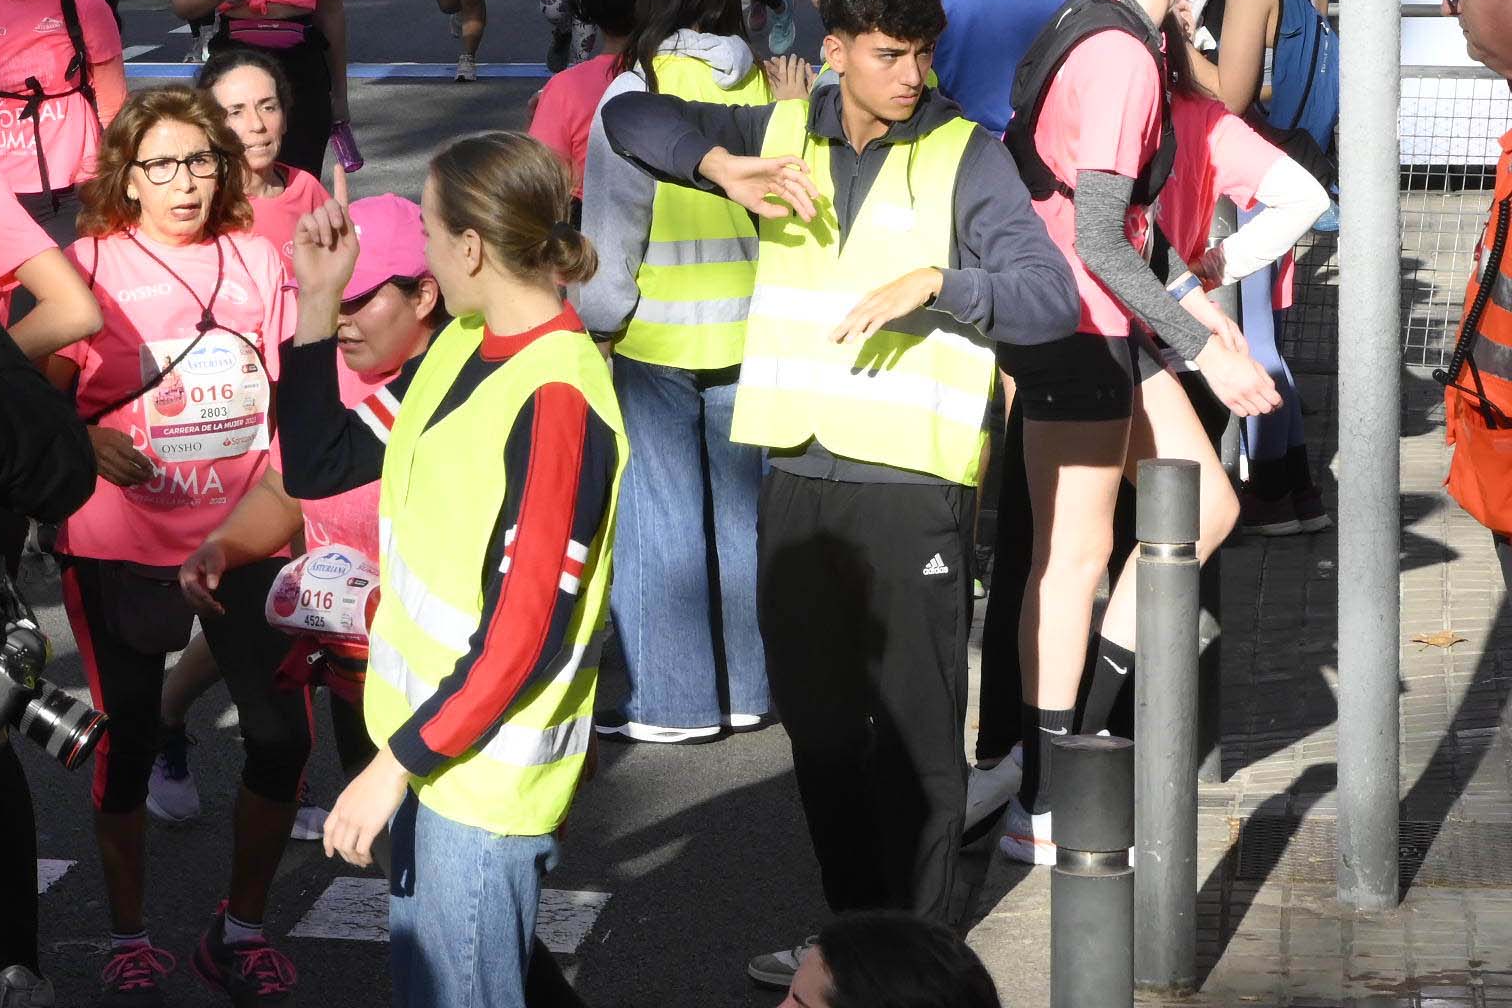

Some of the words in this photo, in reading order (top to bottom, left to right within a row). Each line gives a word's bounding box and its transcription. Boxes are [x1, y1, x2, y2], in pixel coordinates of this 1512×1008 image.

[191, 383, 234, 403] 016
[200, 406, 228, 419] 2803
[163, 425, 200, 436] CARRERA
[201, 424, 212, 432] DE
[213, 422, 223, 430] LA
[224, 419, 244, 429] MUJER
[161, 442, 202, 454] OYSHO
[311, 562, 346, 575] ASTURIANA
[301, 589, 334, 609] 016
[304, 614, 325, 627] 4525
